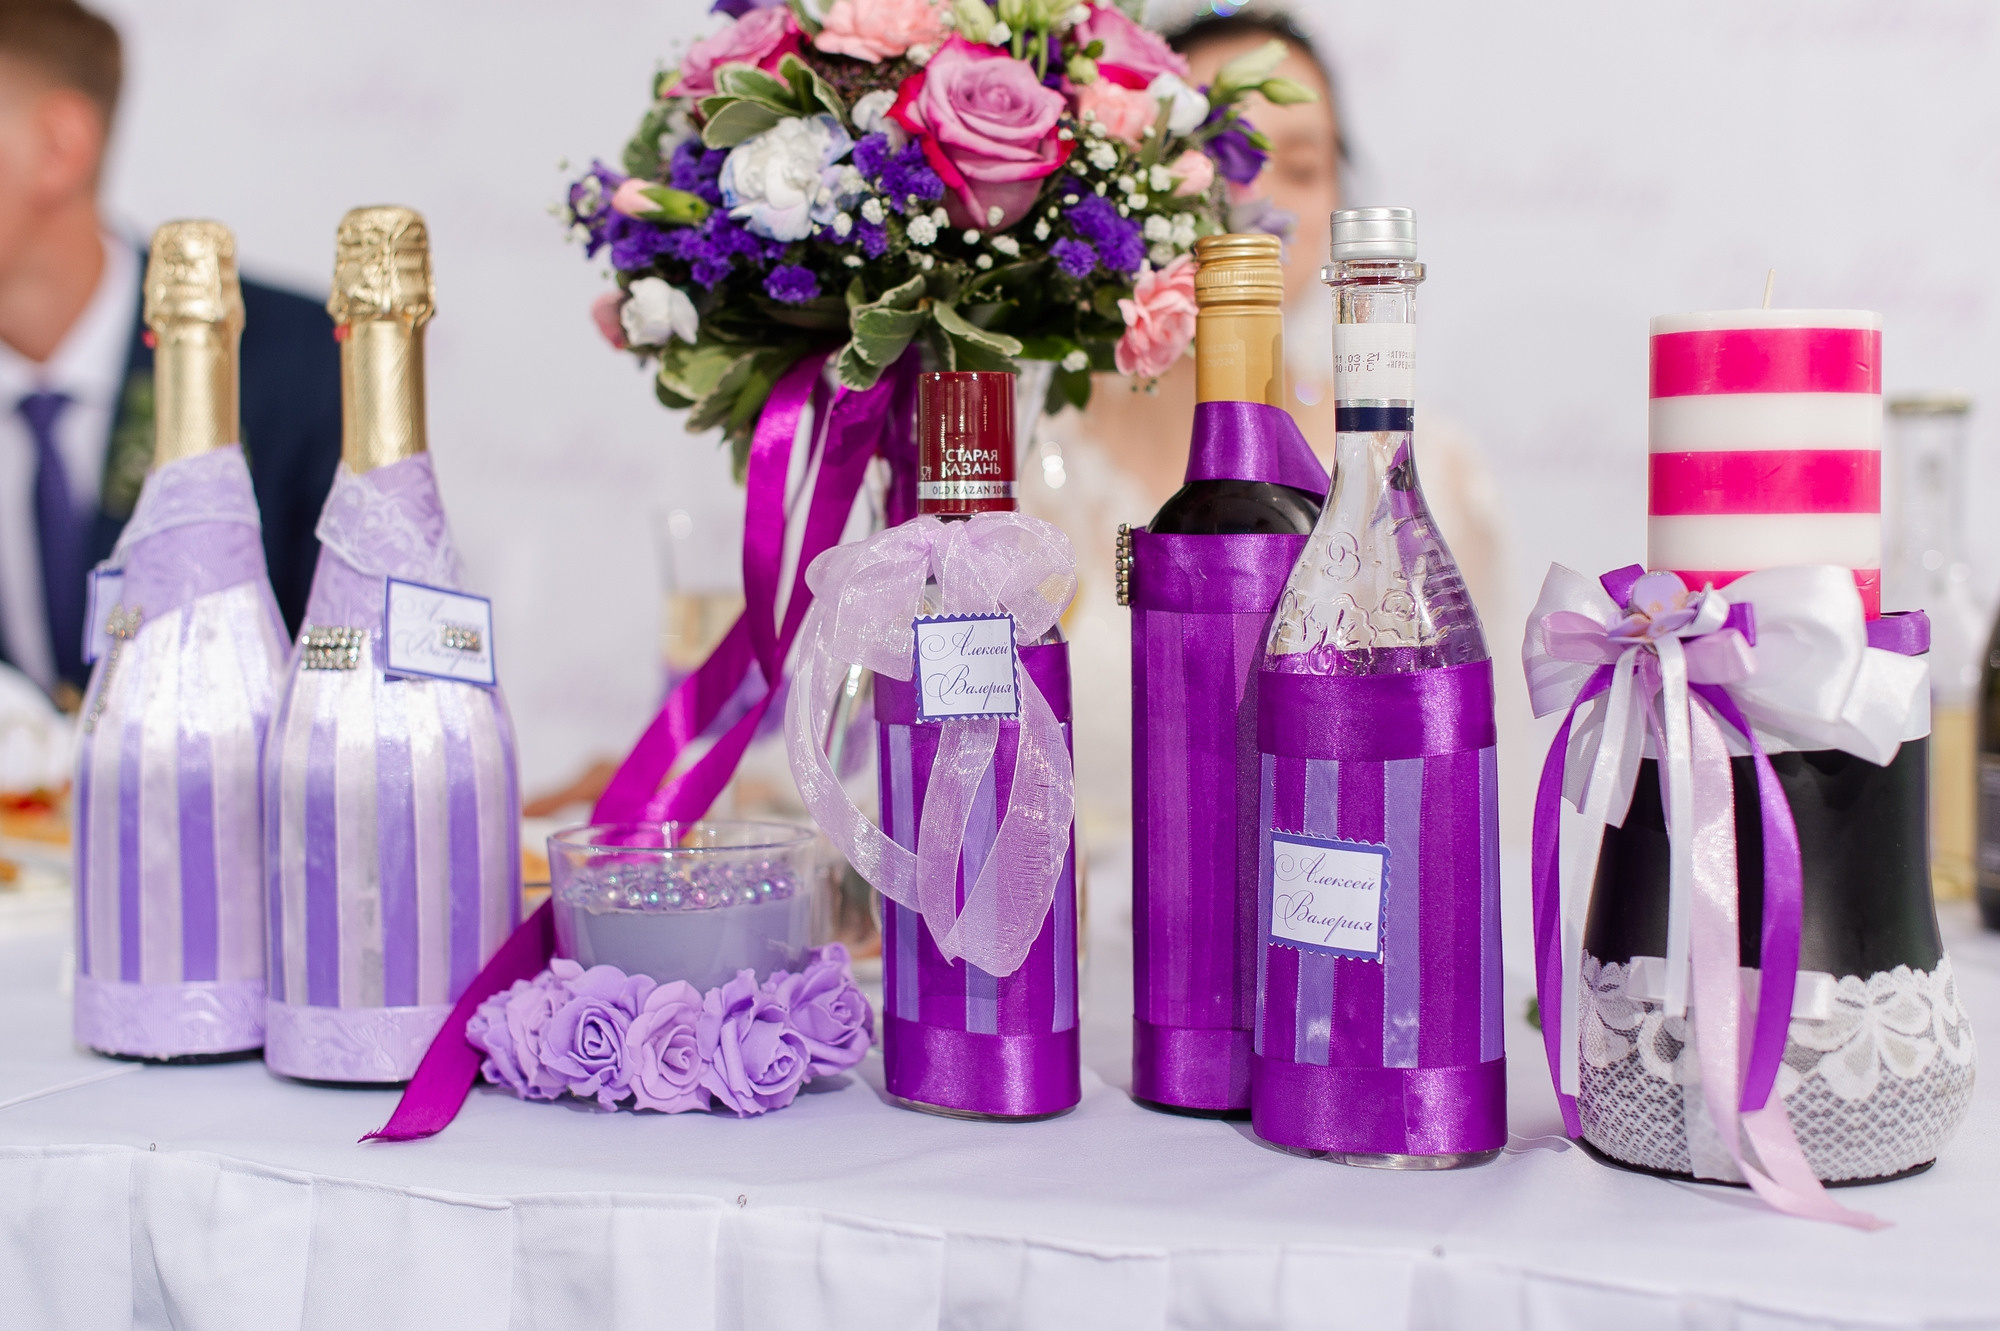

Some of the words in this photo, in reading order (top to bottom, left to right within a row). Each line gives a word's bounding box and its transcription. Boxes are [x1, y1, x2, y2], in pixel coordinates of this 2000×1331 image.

[941, 462, 1001, 476] КАЗАНЬ
[945, 449, 998, 462] СТАРАЯ
[932, 486, 951, 495] OLD
[953, 486, 991, 495] KAZAN
[920, 625, 1009, 661] Алексей
[925, 664, 1013, 710] Валерия
[1275, 853, 1376, 890] Алексей
[1275, 890, 1373, 942] Валерия
